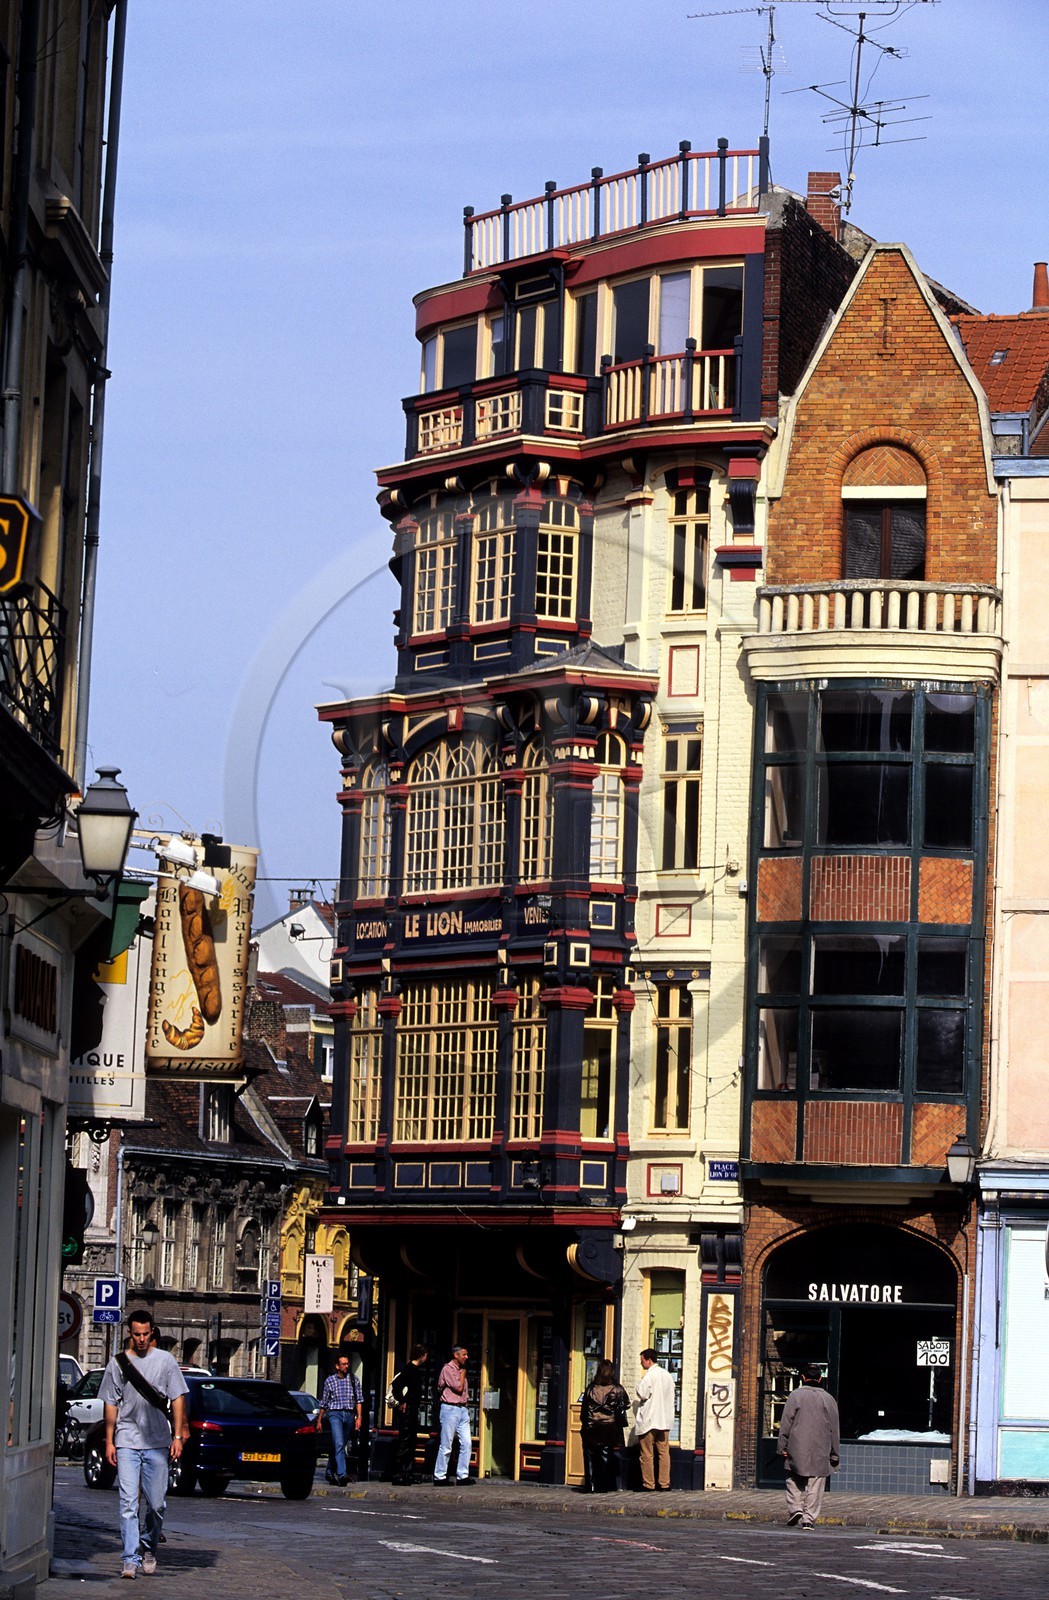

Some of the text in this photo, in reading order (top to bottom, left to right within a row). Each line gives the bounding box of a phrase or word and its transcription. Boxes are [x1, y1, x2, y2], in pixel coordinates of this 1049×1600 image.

[355, 920, 388, 940] LOCATION
[404, 910, 502, 938] LE LION IMMOBILIER
[150, 886, 178, 1049] Boulangerie
[228, 897, 253, 1051] Patisserie
[159, 1056, 242, 1072] Artisan
[713, 1163, 735, 1171] PLACE
[101, 1284, 114, 1303] P
[271, 1284, 279, 1295] P
[808, 1283, 903, 1303] SALVATORE
[917, 1340, 949, 1350] SABOTS
